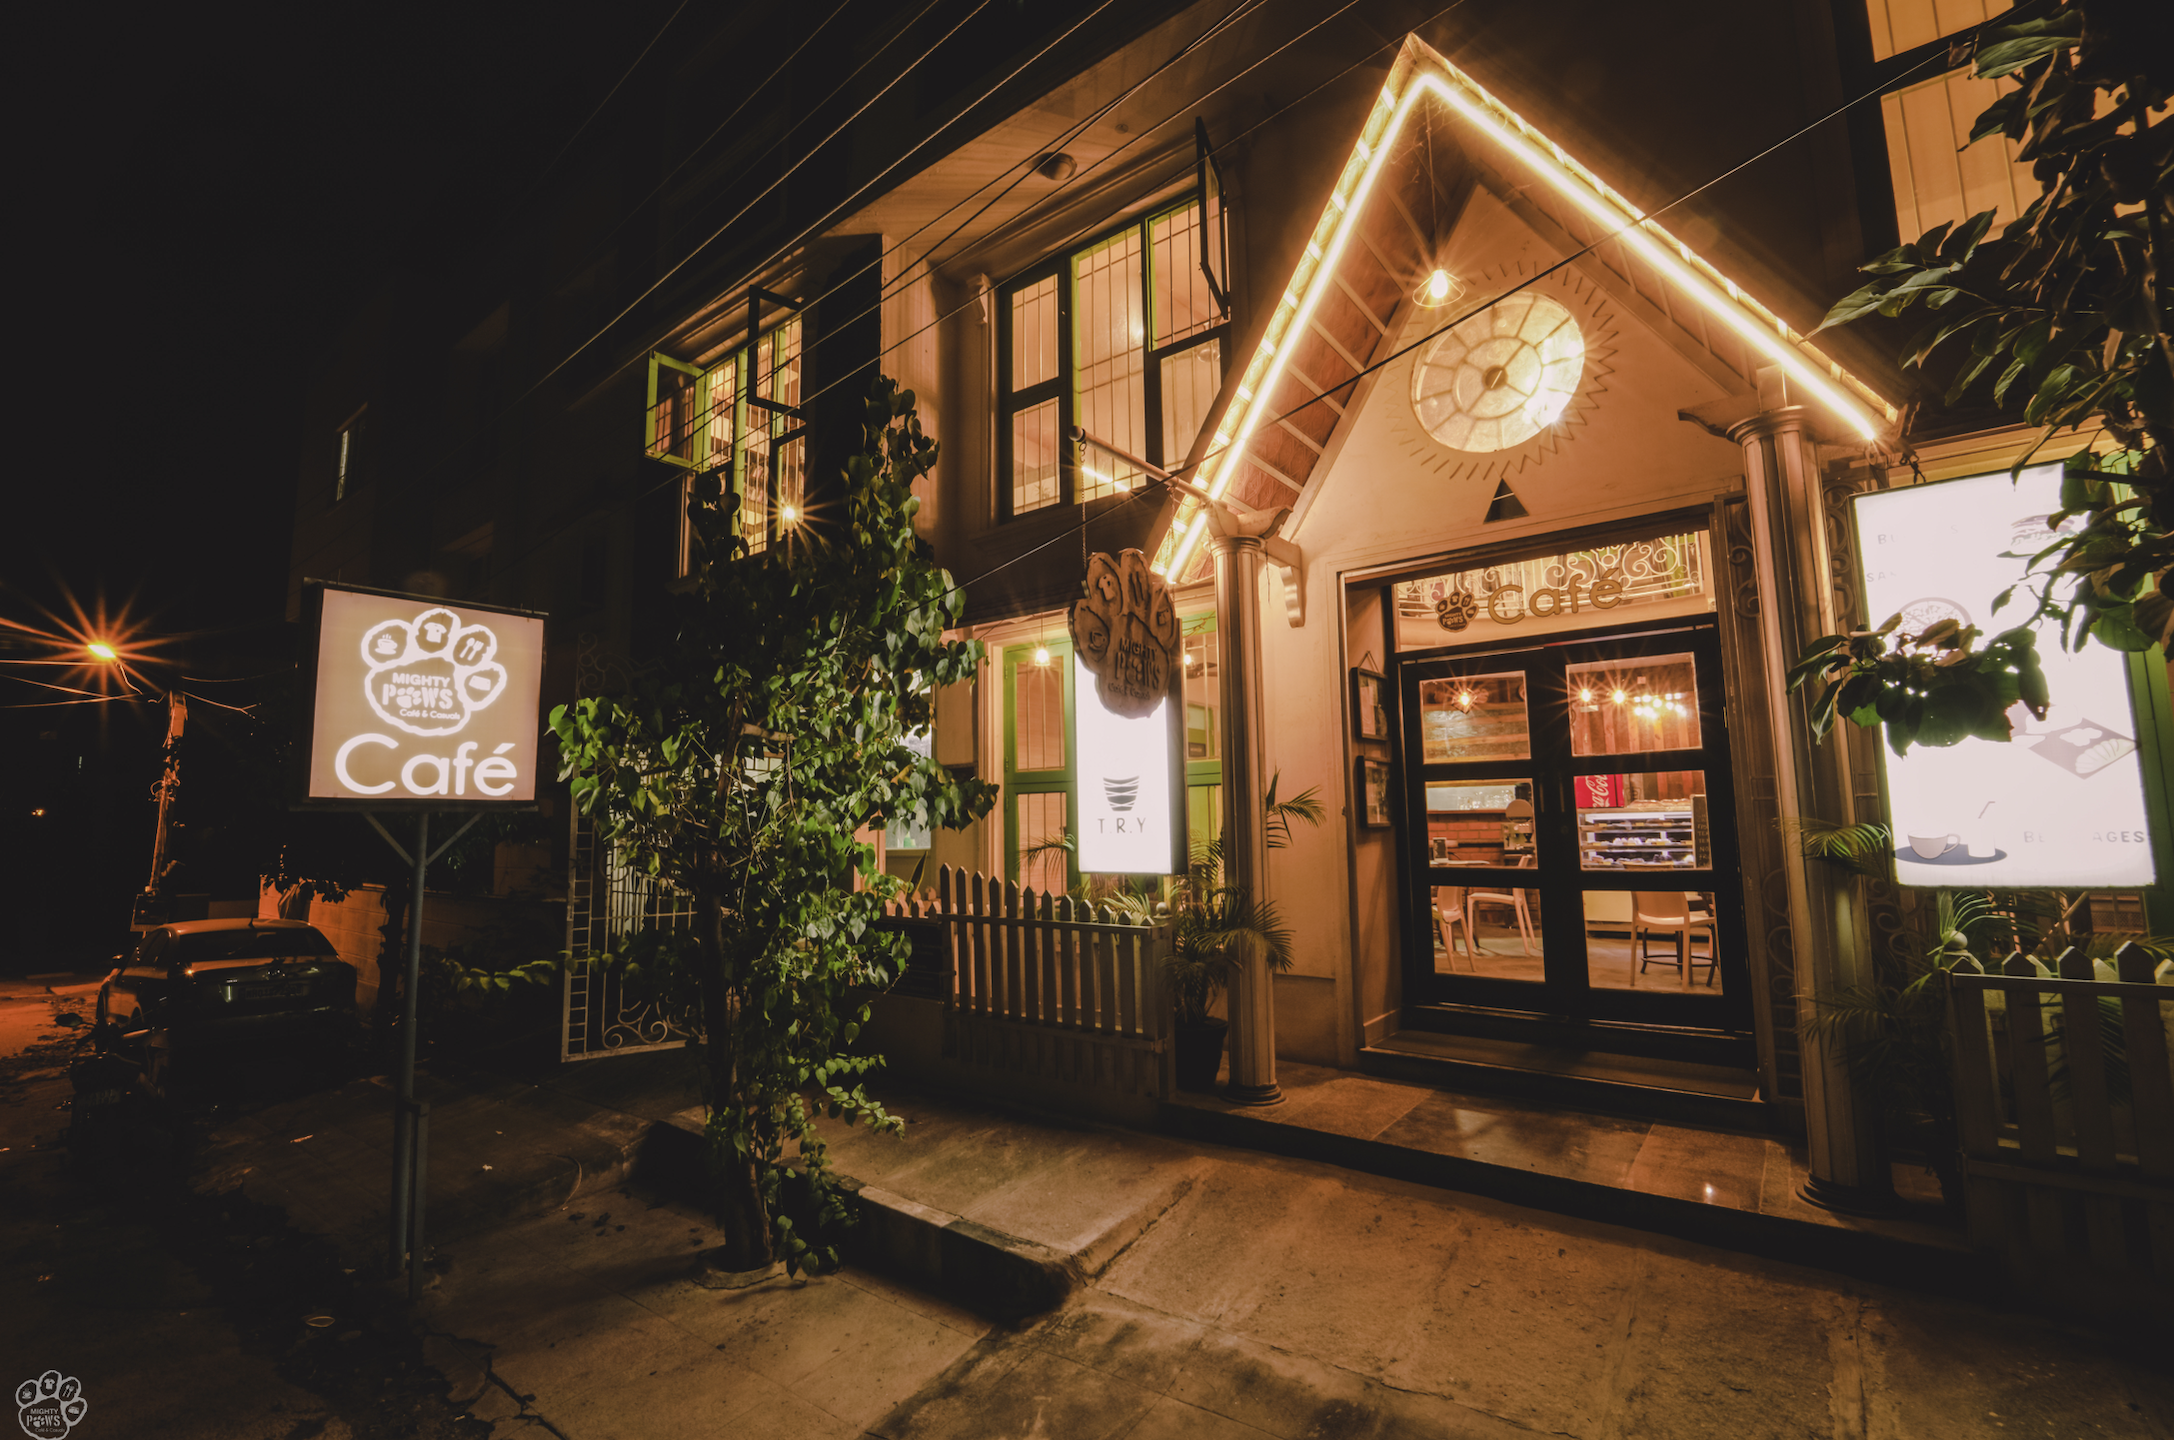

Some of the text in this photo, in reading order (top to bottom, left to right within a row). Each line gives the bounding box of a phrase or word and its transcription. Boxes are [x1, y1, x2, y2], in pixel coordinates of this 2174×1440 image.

[1487, 567, 1623, 625] Café
[392, 672, 451, 688] MIGHTY
[335, 732, 518, 796] Café
